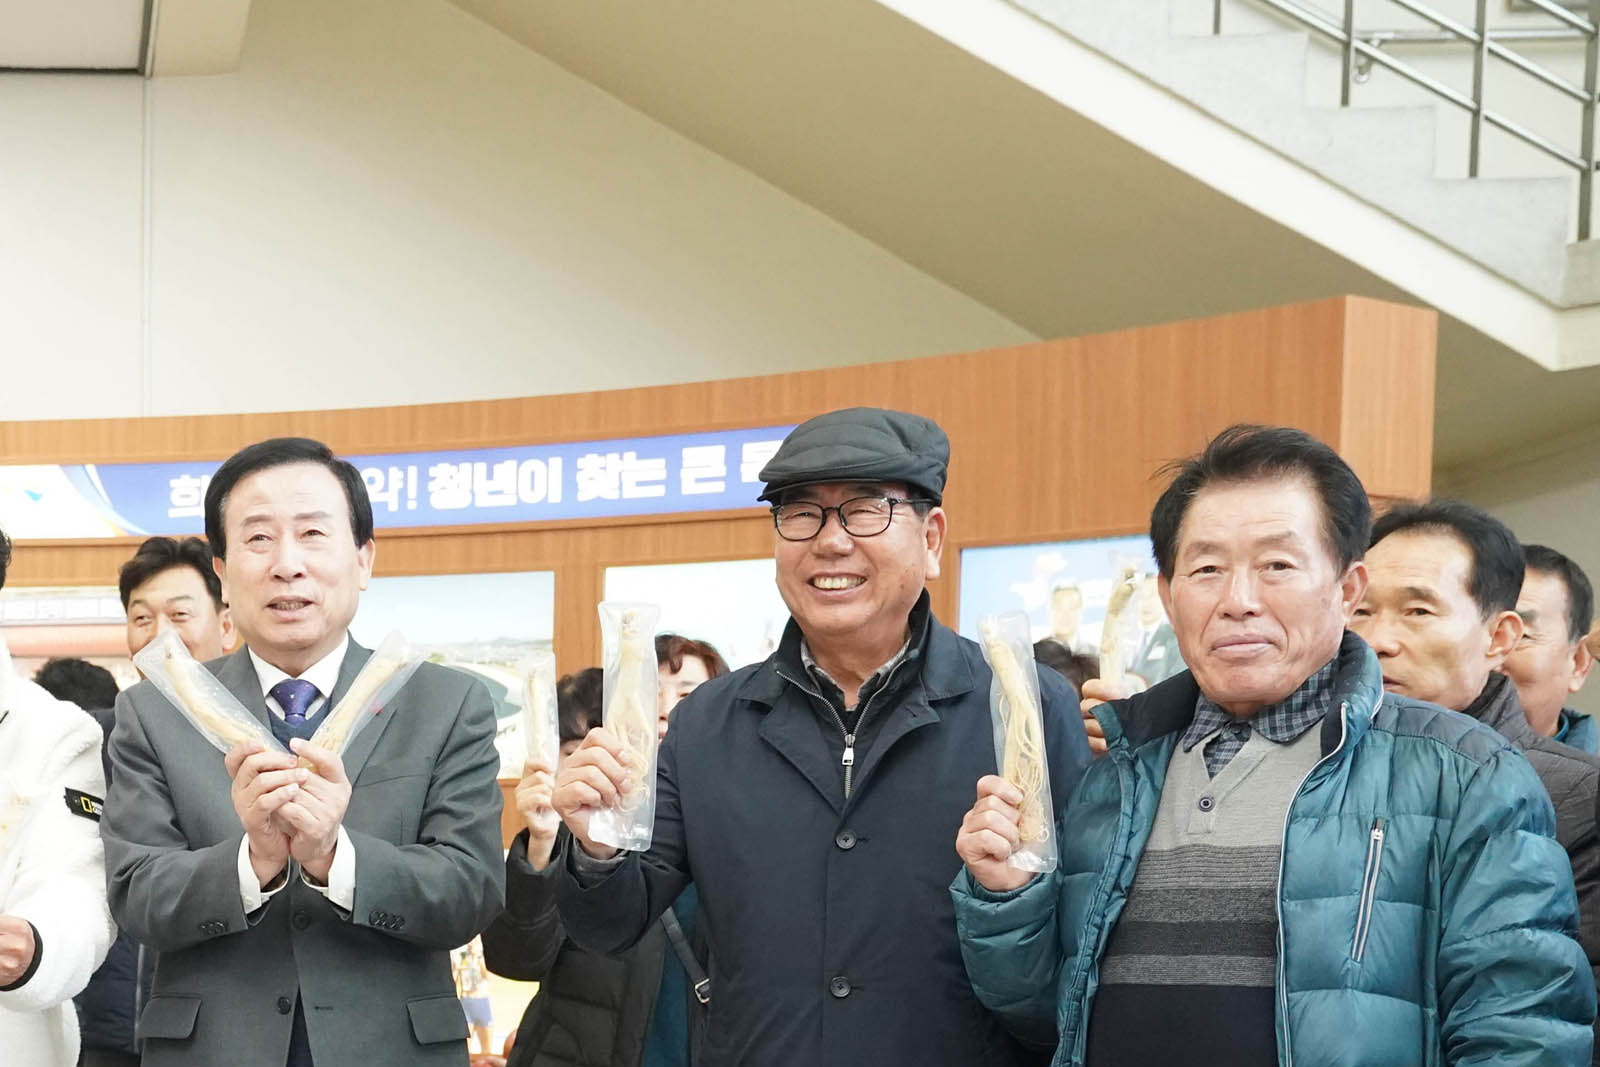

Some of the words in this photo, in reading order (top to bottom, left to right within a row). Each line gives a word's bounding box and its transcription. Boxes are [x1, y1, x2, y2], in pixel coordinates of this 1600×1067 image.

[361, 464, 418, 512] 약!
[428, 456, 563, 509] 청년이
[576, 450, 667, 502] 찾는
[680, 445, 727, 495] 큰
